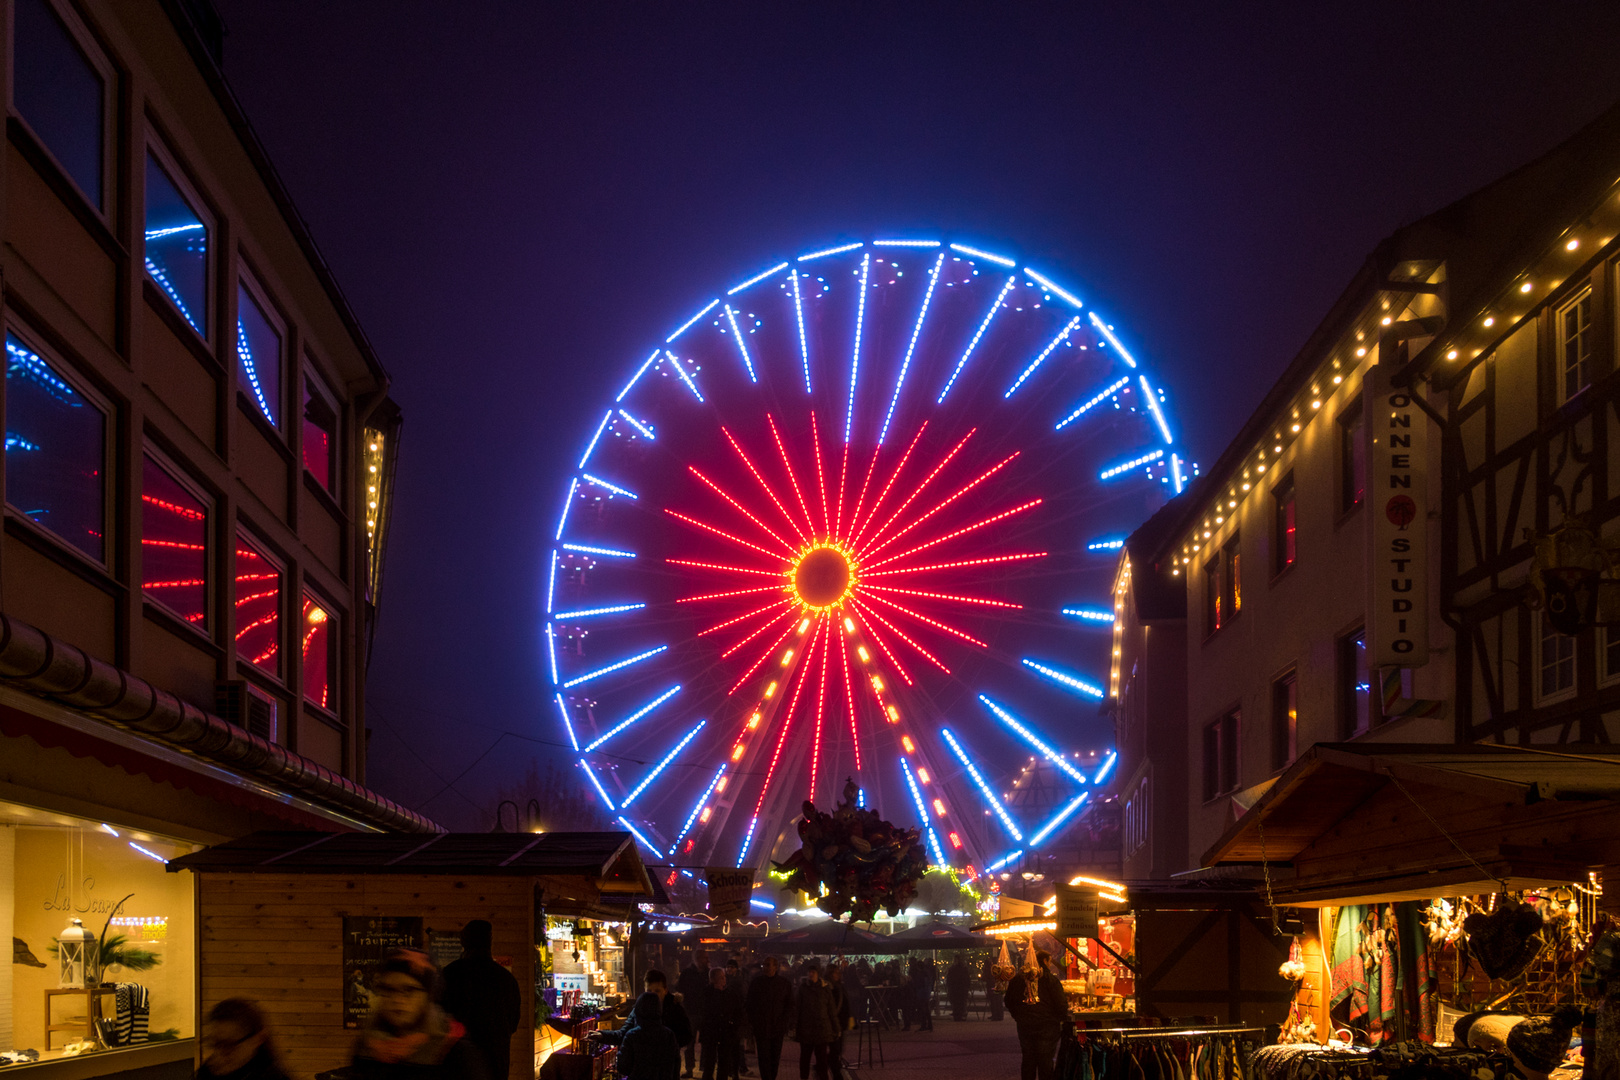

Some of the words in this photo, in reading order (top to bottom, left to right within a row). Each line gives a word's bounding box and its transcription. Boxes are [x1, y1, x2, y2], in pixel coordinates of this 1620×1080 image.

[1388, 392, 1413, 490] ONNEN
[1390, 537, 1415, 654] STUDIO
[43, 872, 71, 911] La
[350, 931, 414, 947] Traumzeit
